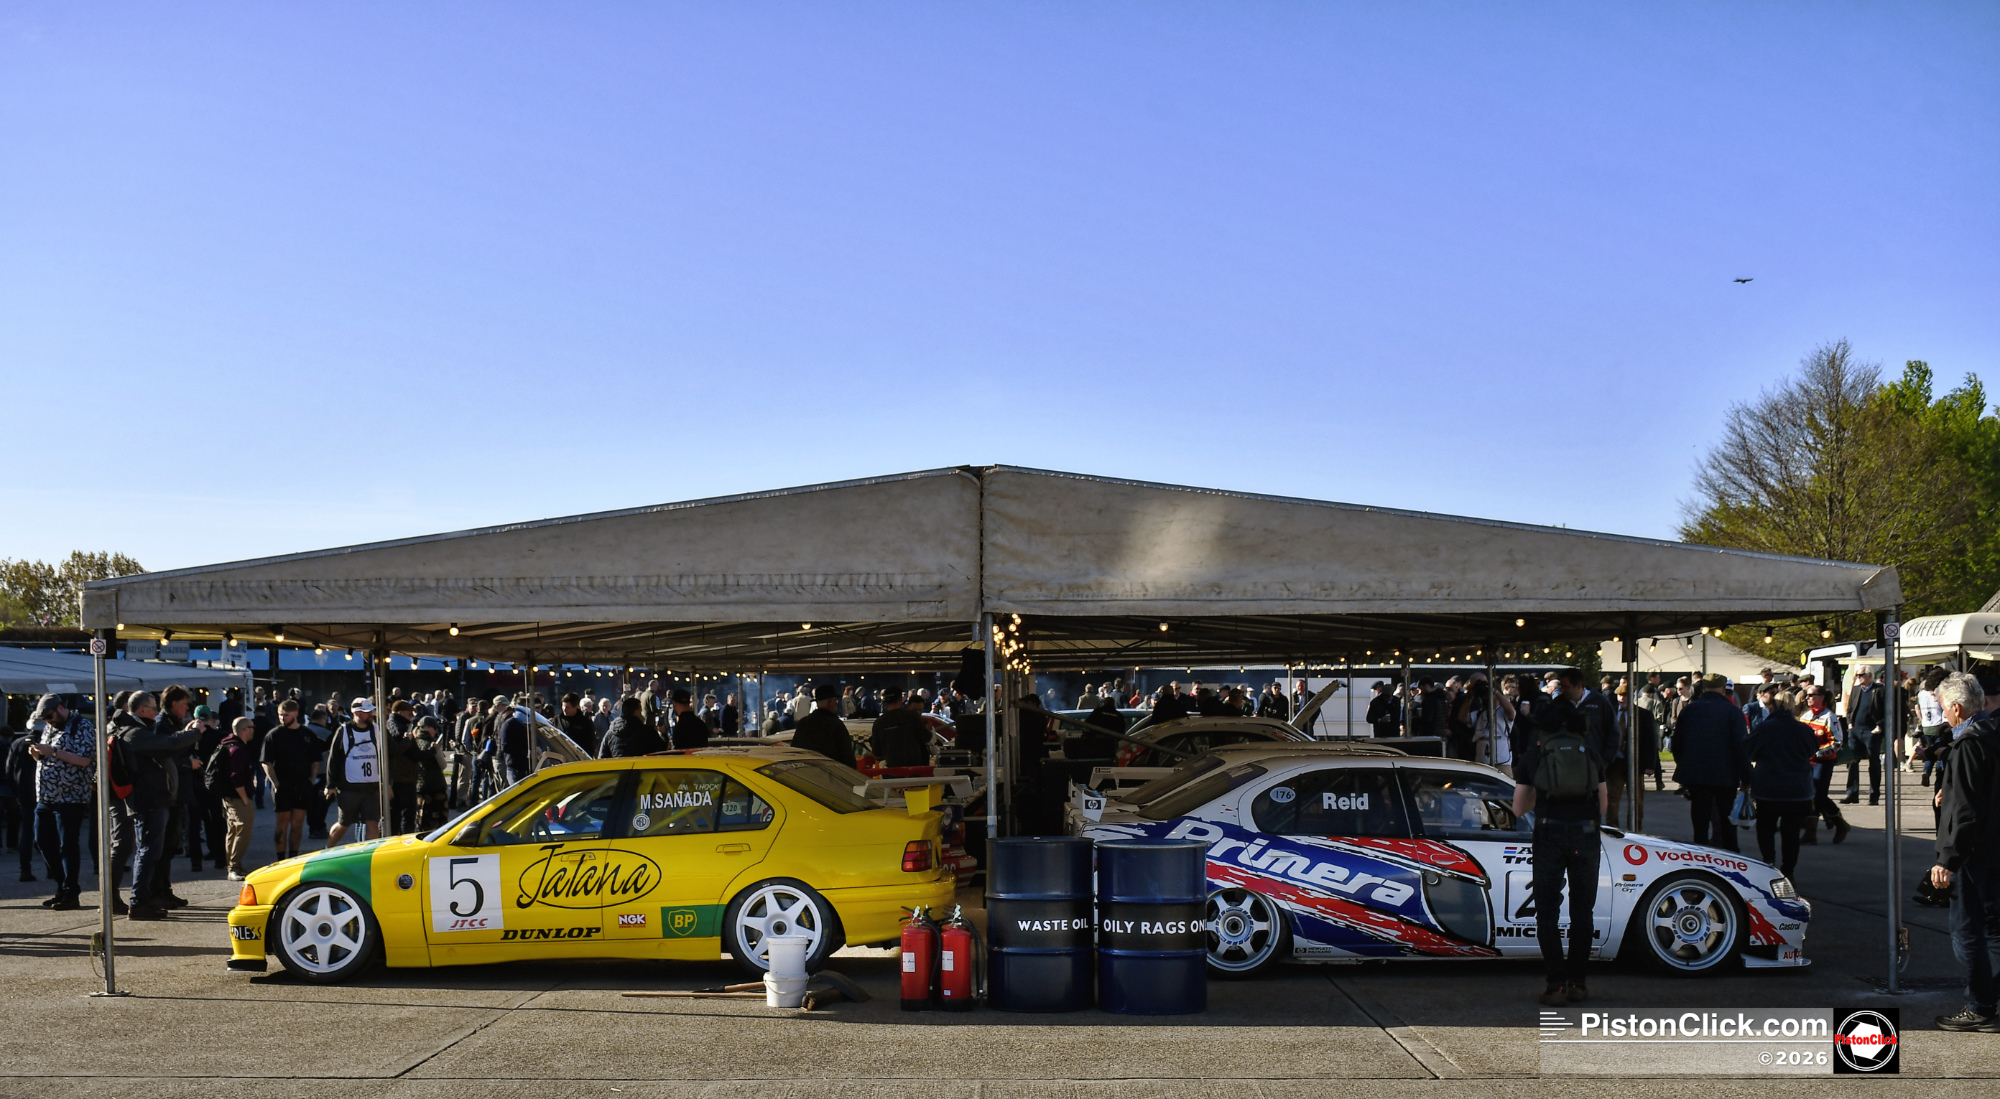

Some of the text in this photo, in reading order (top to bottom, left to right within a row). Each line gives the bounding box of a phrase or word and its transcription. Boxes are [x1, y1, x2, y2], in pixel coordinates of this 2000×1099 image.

[1906, 619, 1952, 638] COFFEE
[361, 762, 372, 777] 18
[640, 791, 713, 810] M.SANADA
[1276, 790, 1292, 799] 176
[1323, 792, 1369, 810] Reid
[725, 804, 738, 812] 320
[1164, 819, 1415, 907] Primera
[1655, 850, 1748, 872] vodafone
[449, 857, 484, 917] 5
[450, 918, 488, 928] JTCC
[618, 914, 646, 925] NGK
[674, 915, 694, 928] BP
[1017, 918, 1089, 931] WASTE OIL
[1103, 919, 1134, 934] OILY
[1141, 921, 1186, 934] RAGS
[1779, 922, 1801, 930] Castrol
[500, 927, 601, 941] DUNLOP
